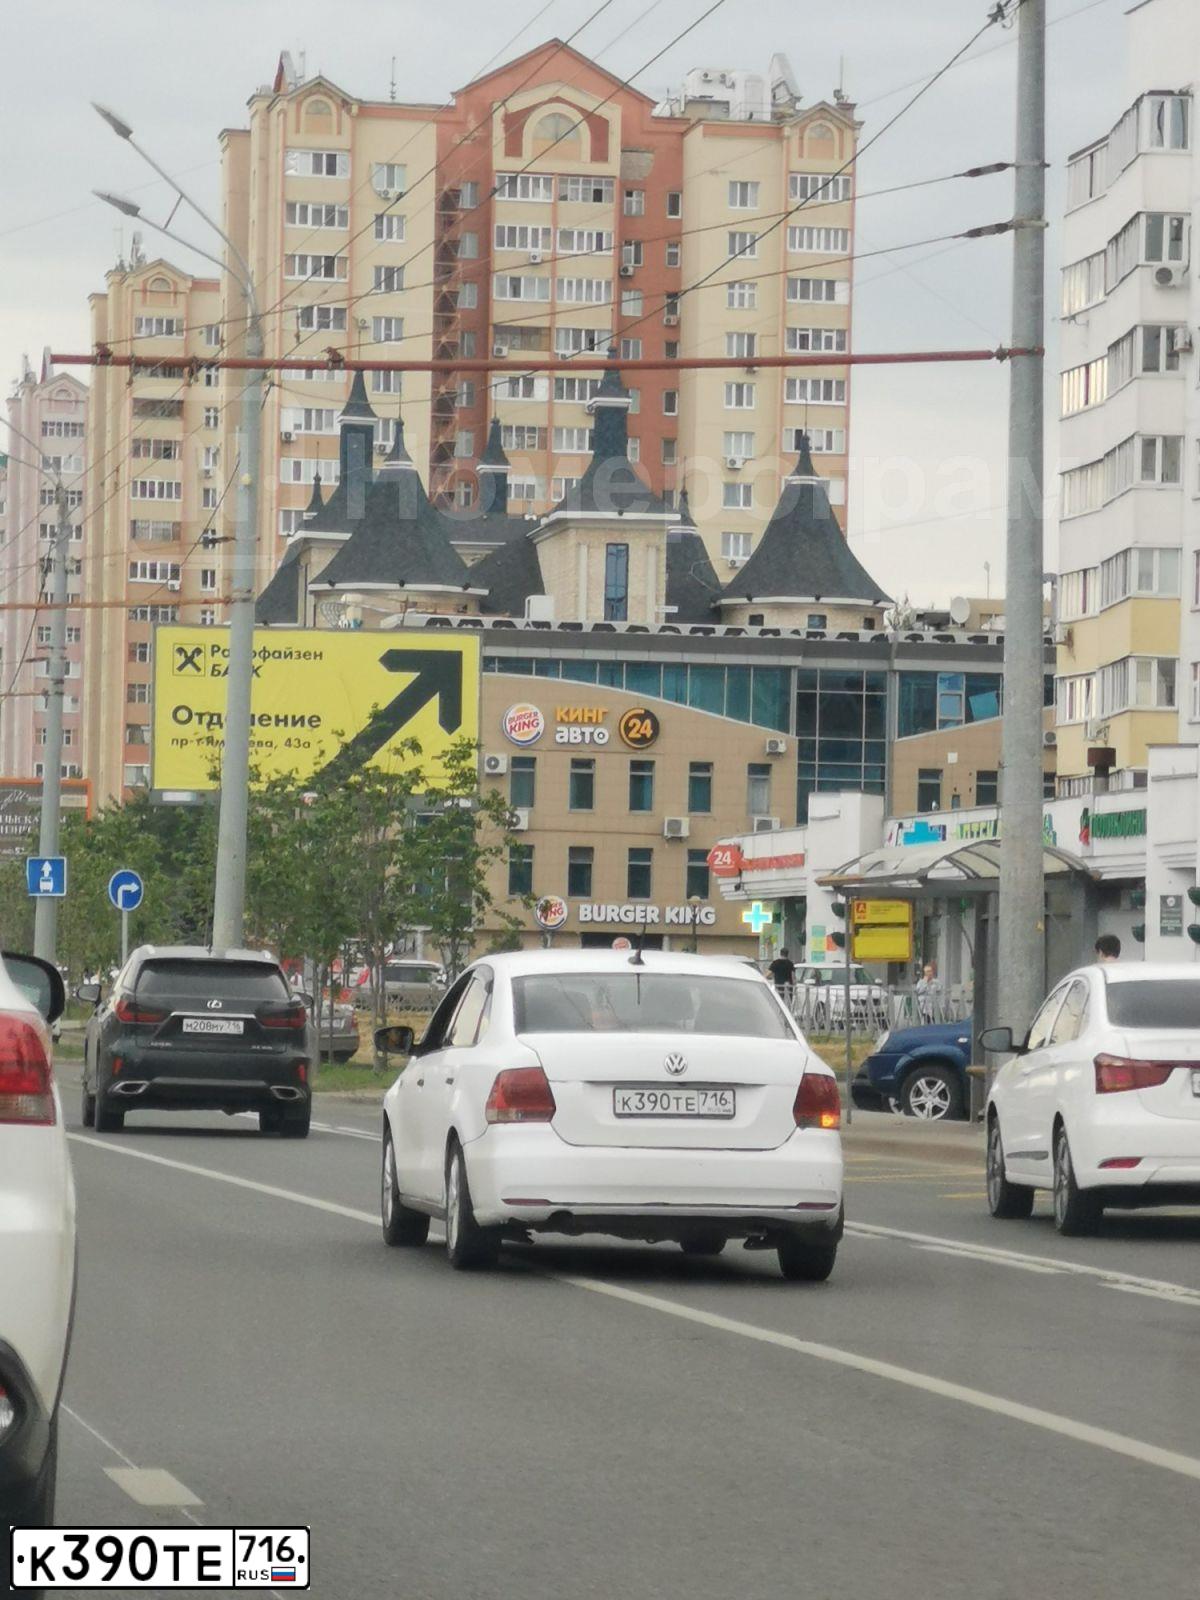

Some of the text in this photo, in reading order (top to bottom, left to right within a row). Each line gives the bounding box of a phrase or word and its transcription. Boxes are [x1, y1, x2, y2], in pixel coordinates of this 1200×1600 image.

[211, 644, 323, 662] Рафайзен
[171, 704, 322, 729] Отдение
[508, 711, 539, 725] BURGER
[556, 706, 609, 723] КИНГ
[509, 718, 540, 735] KING
[627, 718, 653, 739] 24
[713, 850, 732, 866] 24
[579, 903, 717, 925] BURGER KING
[621, 1091, 728, 1112] К390ТЕ 716
